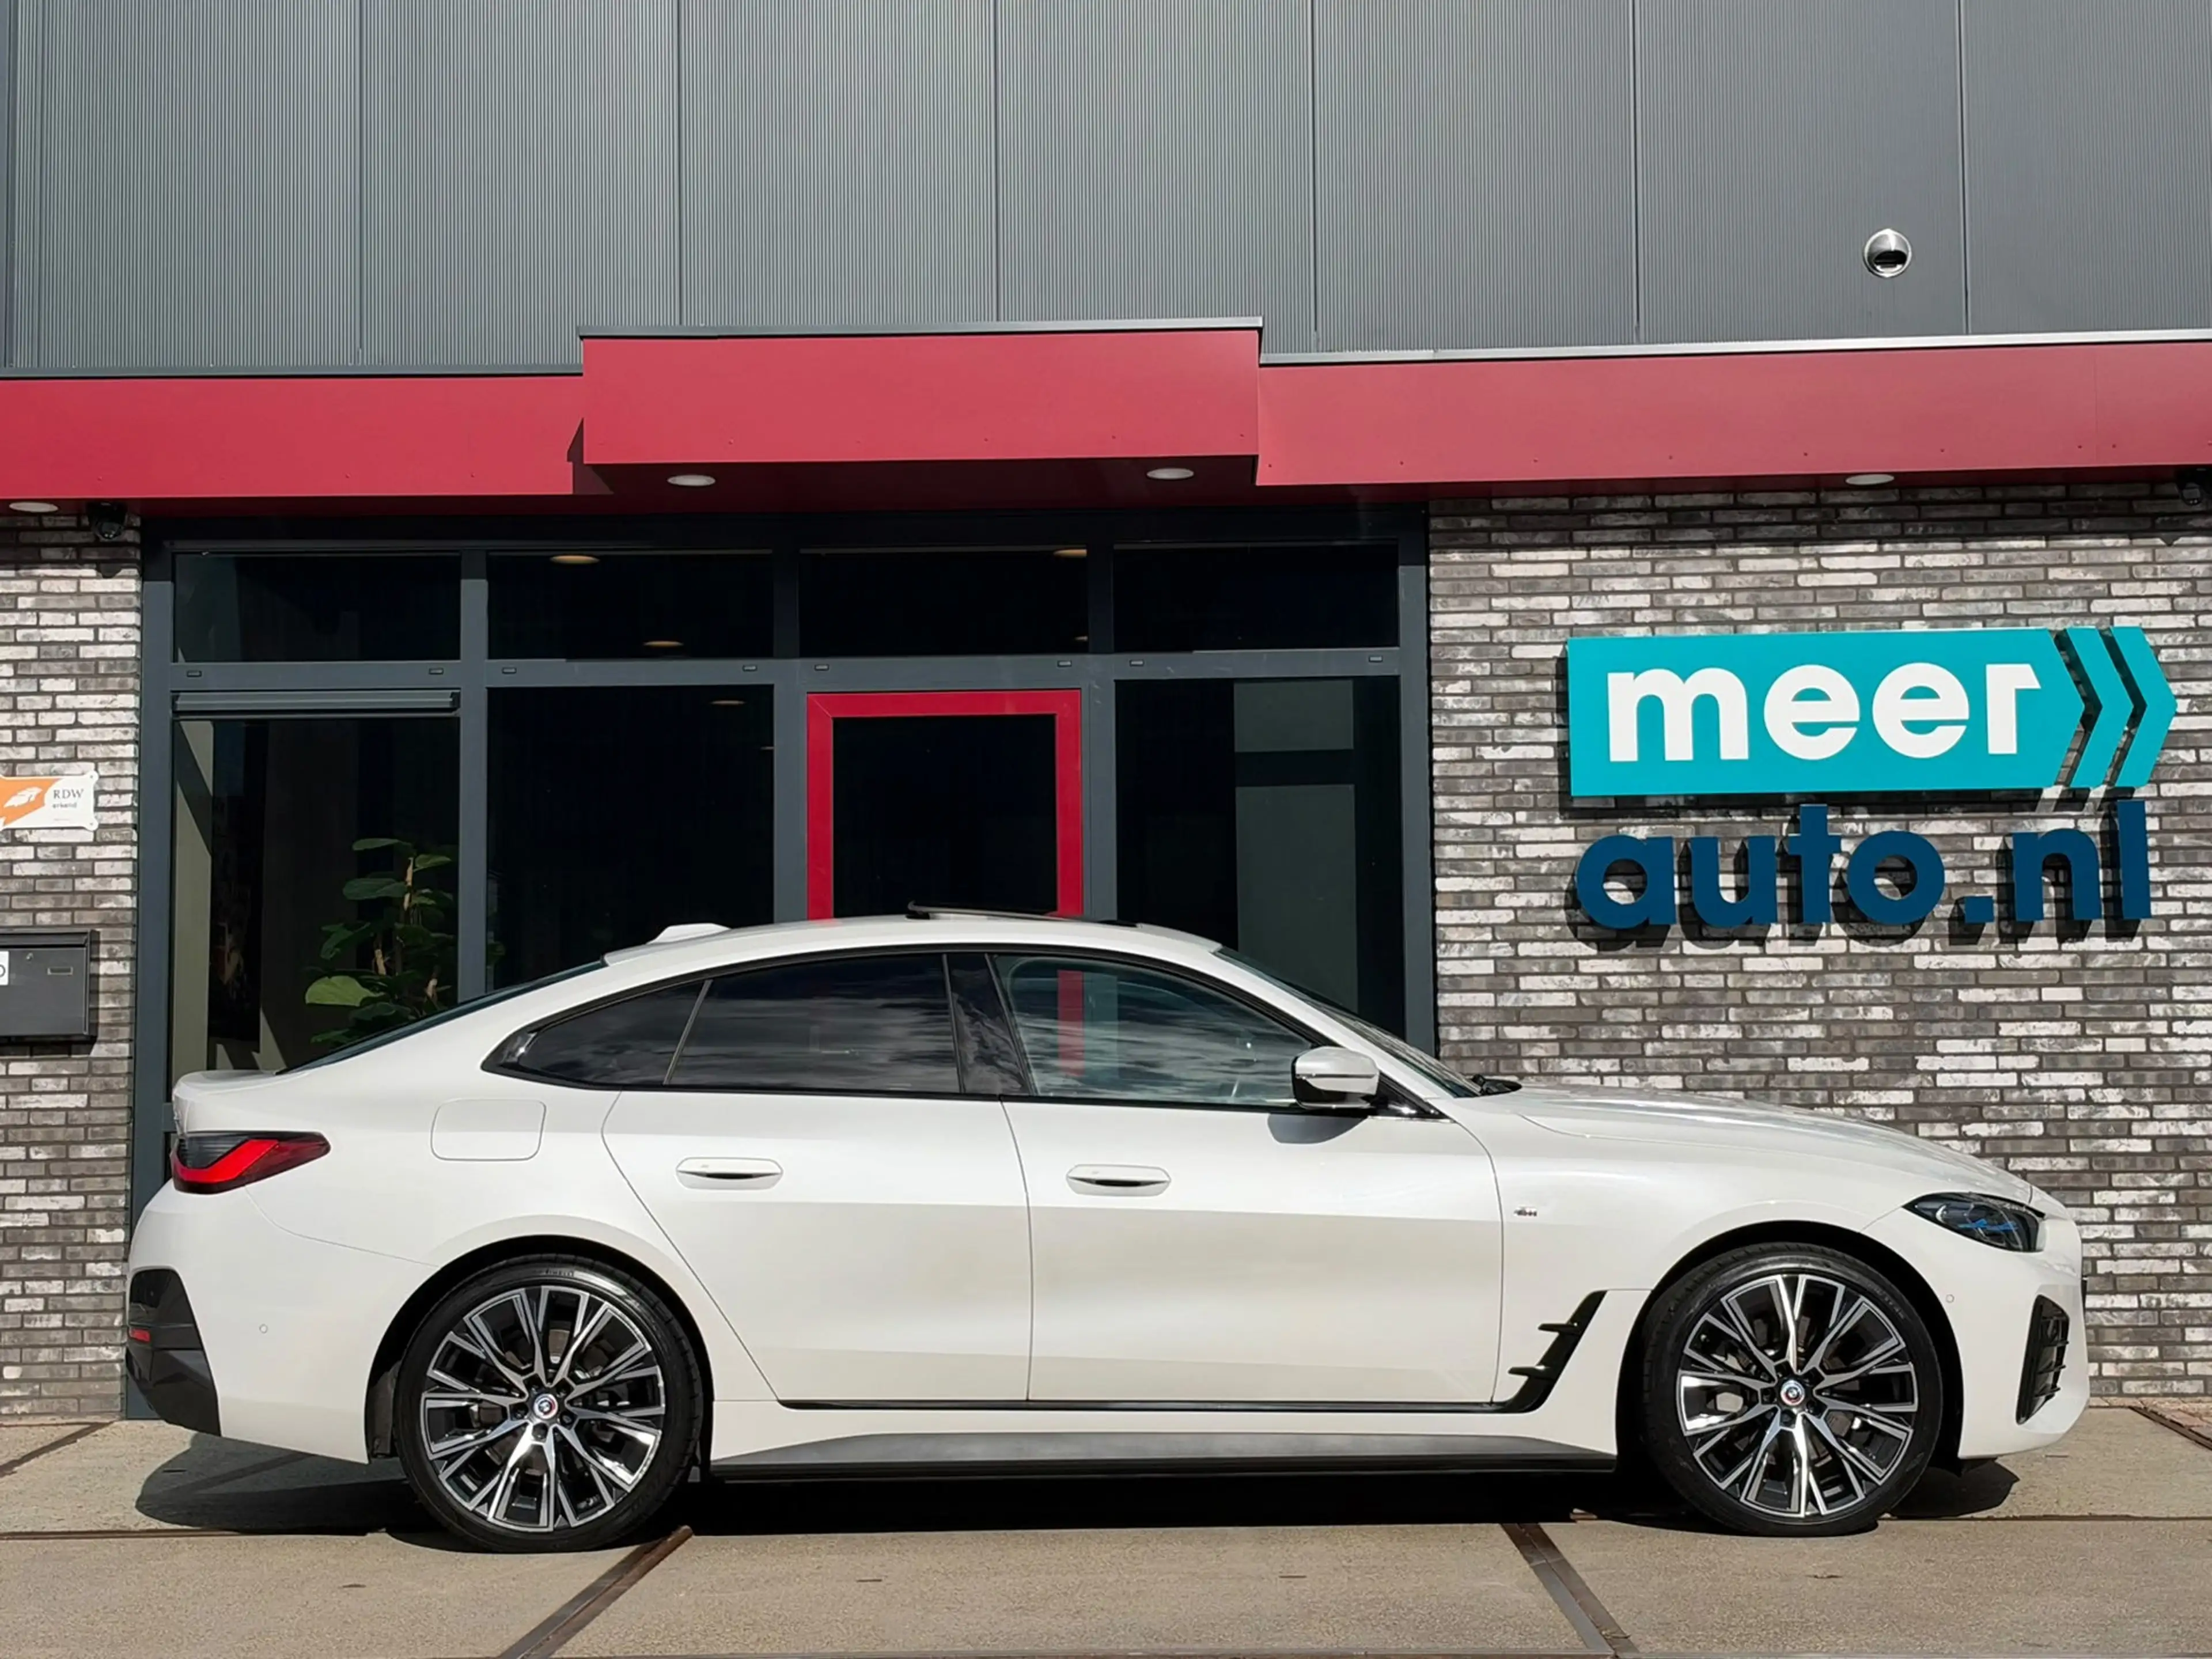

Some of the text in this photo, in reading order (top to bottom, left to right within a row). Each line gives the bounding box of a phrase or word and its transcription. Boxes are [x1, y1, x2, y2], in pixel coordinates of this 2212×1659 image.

[1608, 662, 2041, 762] meer
[54, 789, 84, 799] RDW
[1576, 800, 2152, 929] auto.nl
